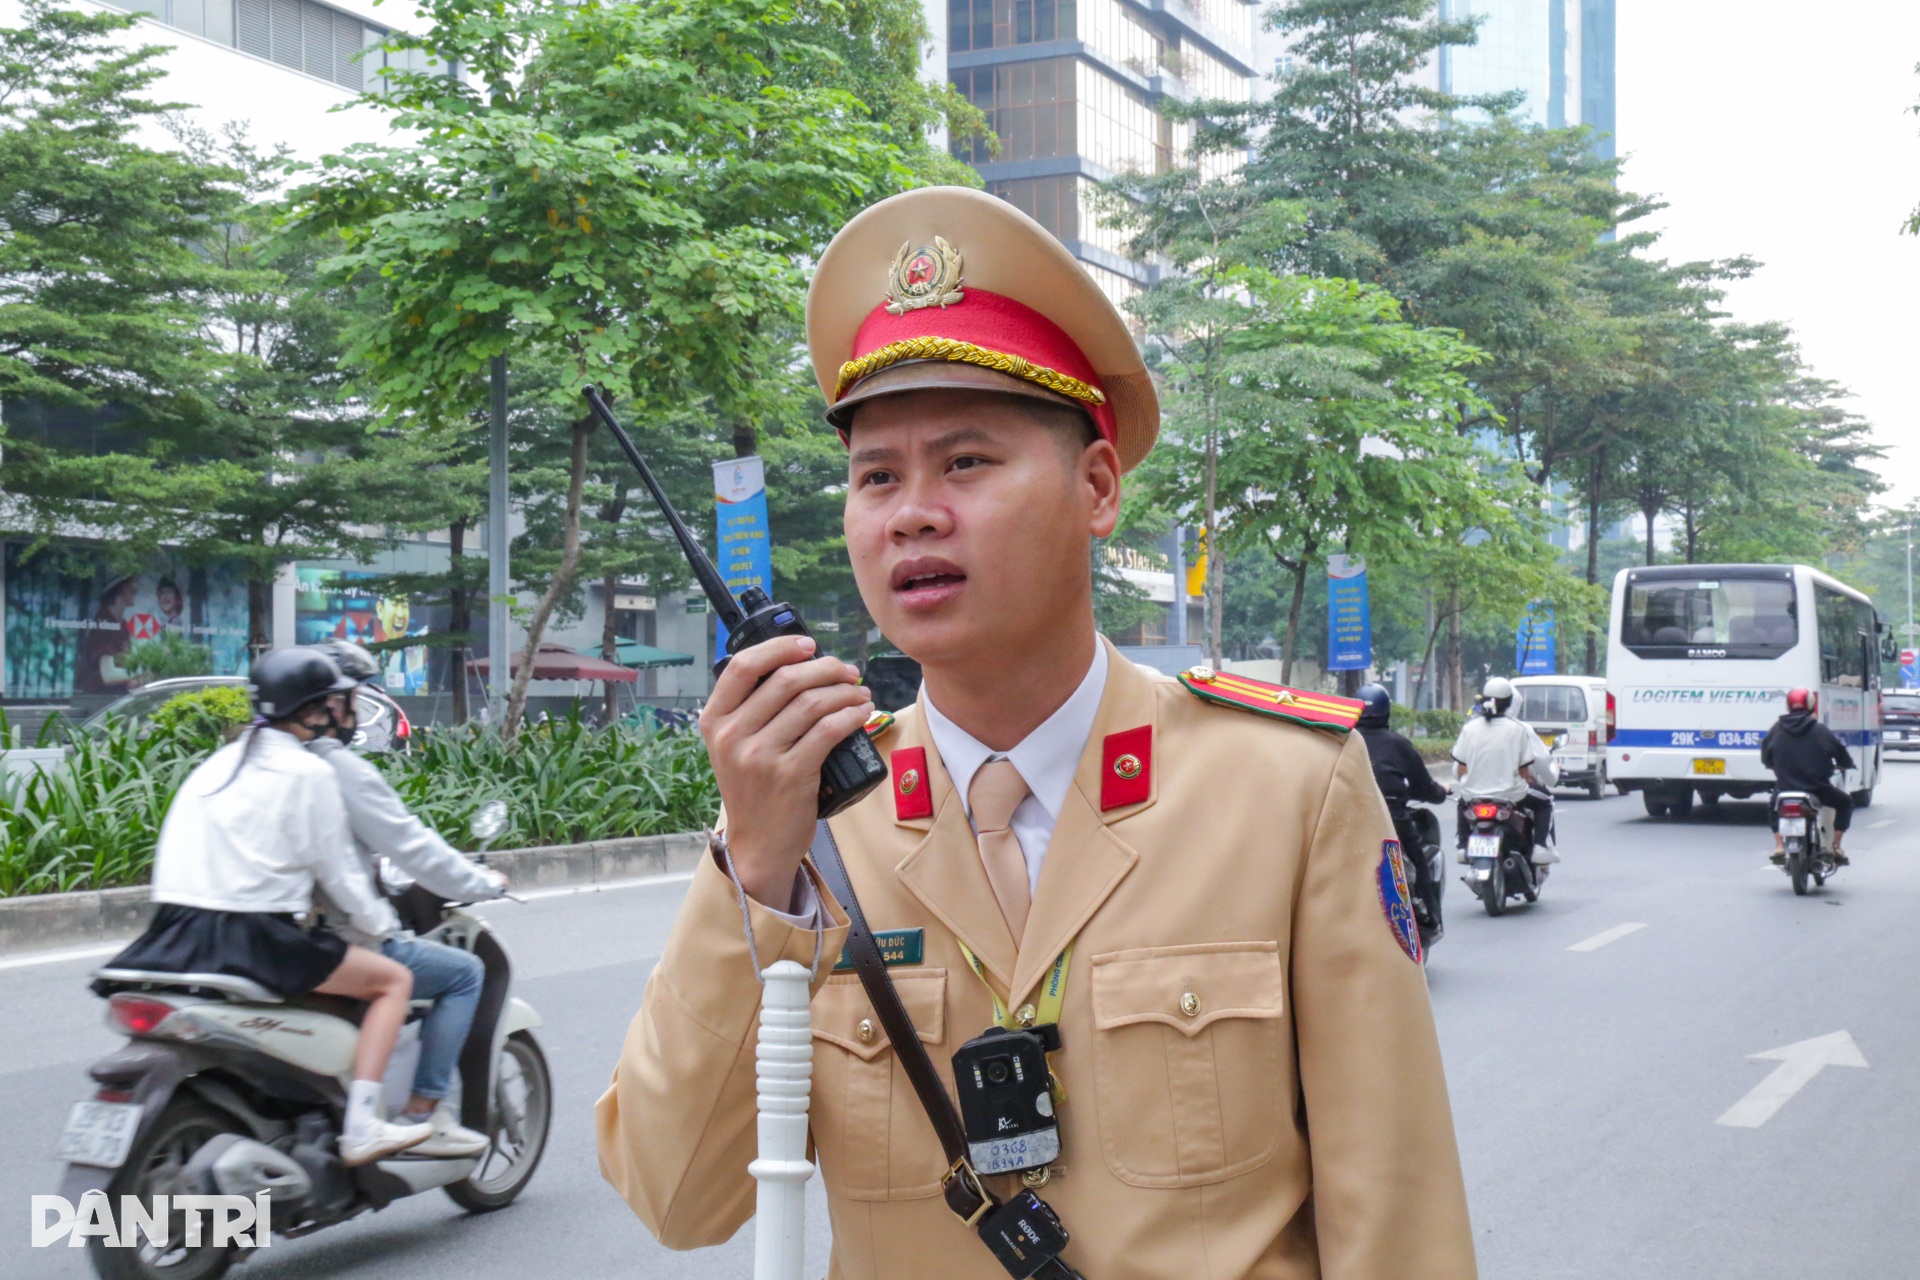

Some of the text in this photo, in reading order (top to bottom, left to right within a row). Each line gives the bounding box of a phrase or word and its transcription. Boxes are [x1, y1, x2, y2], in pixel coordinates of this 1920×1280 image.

[1632, 690, 1781, 703] LOGITEM VIETNA
[1718, 732, 1760, 746] 034-65
[990, 1139, 1027, 1156] 0368
